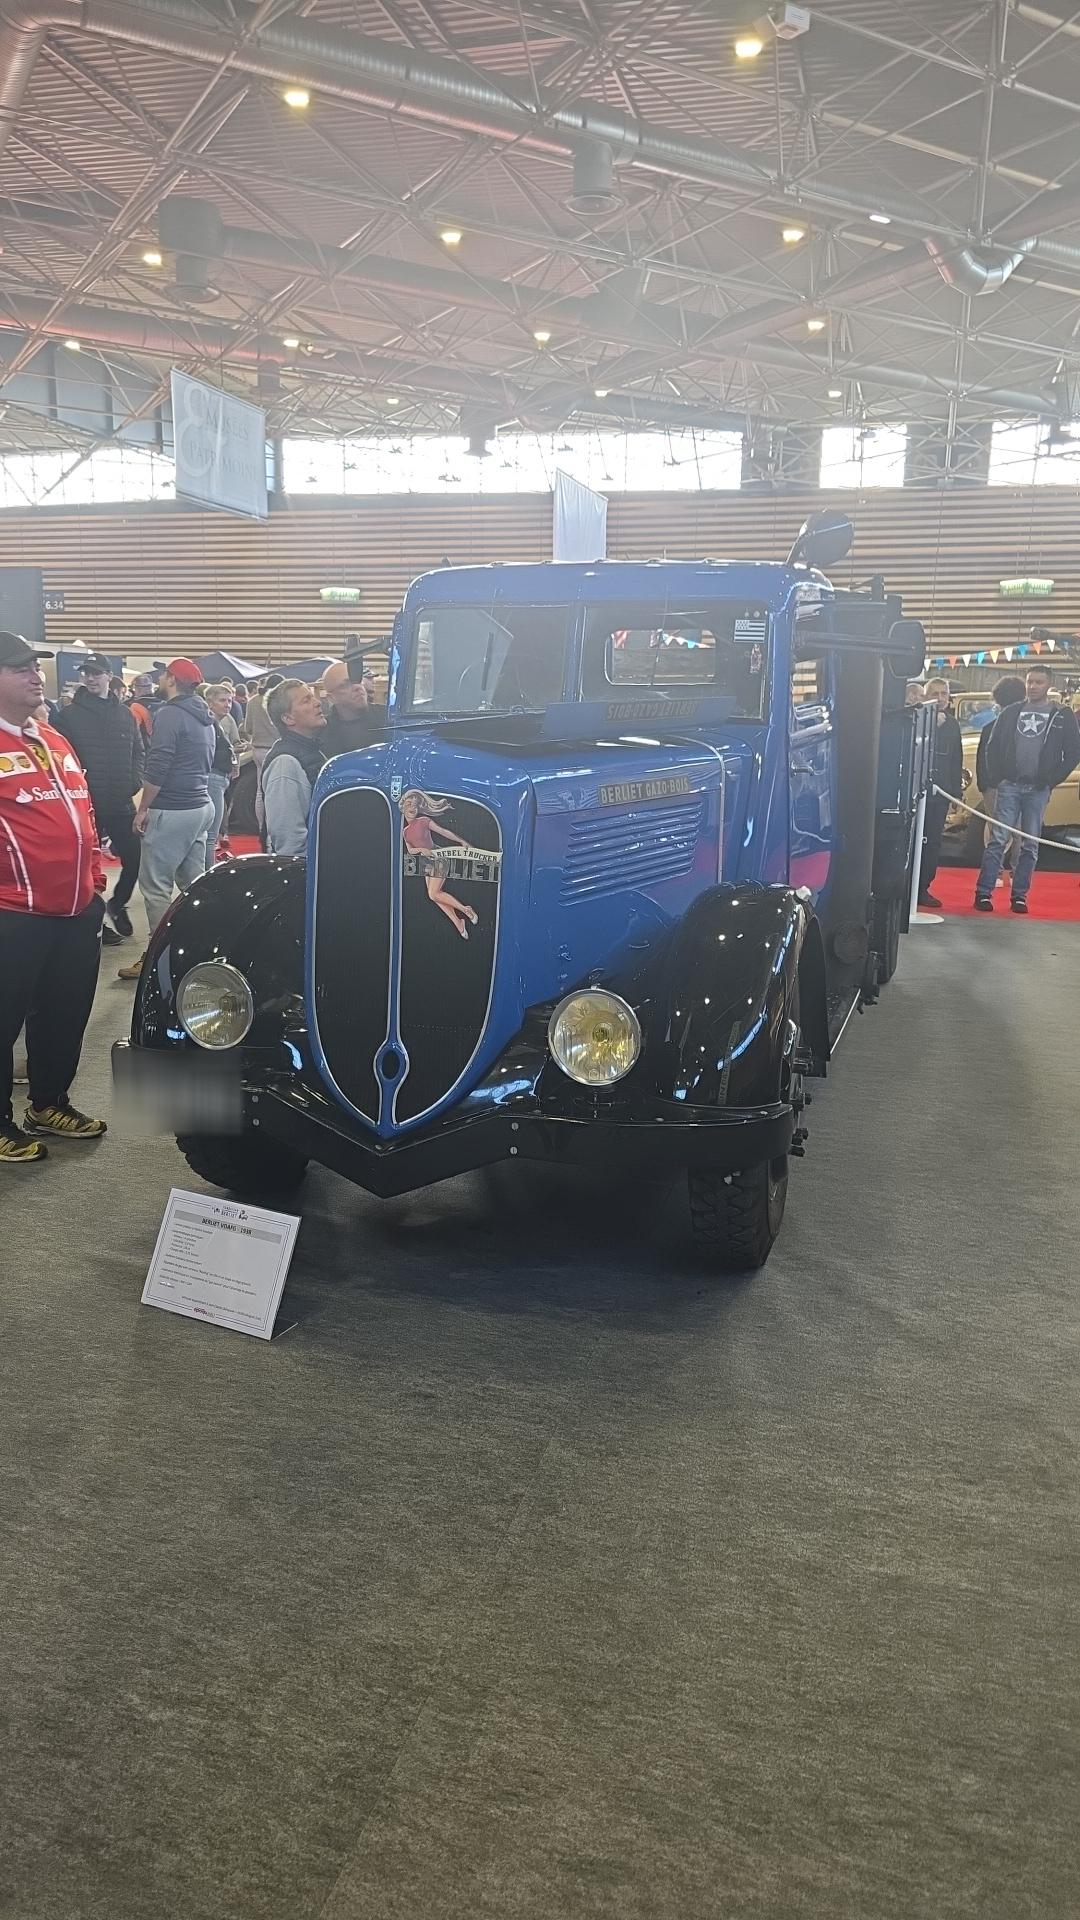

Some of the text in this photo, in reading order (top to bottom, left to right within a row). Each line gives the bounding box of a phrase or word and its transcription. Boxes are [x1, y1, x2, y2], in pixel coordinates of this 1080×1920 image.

[190, 440, 256, 480] PATRMOINE
[45, 600, 63, 610] 6.34
[600, 783, 643, 804] BERLIET
[437, 849, 498, 862] REBEL TRUCKER
[404, 855, 499, 881] BLIET
[202, 1218, 220, 1227] BERLIET
